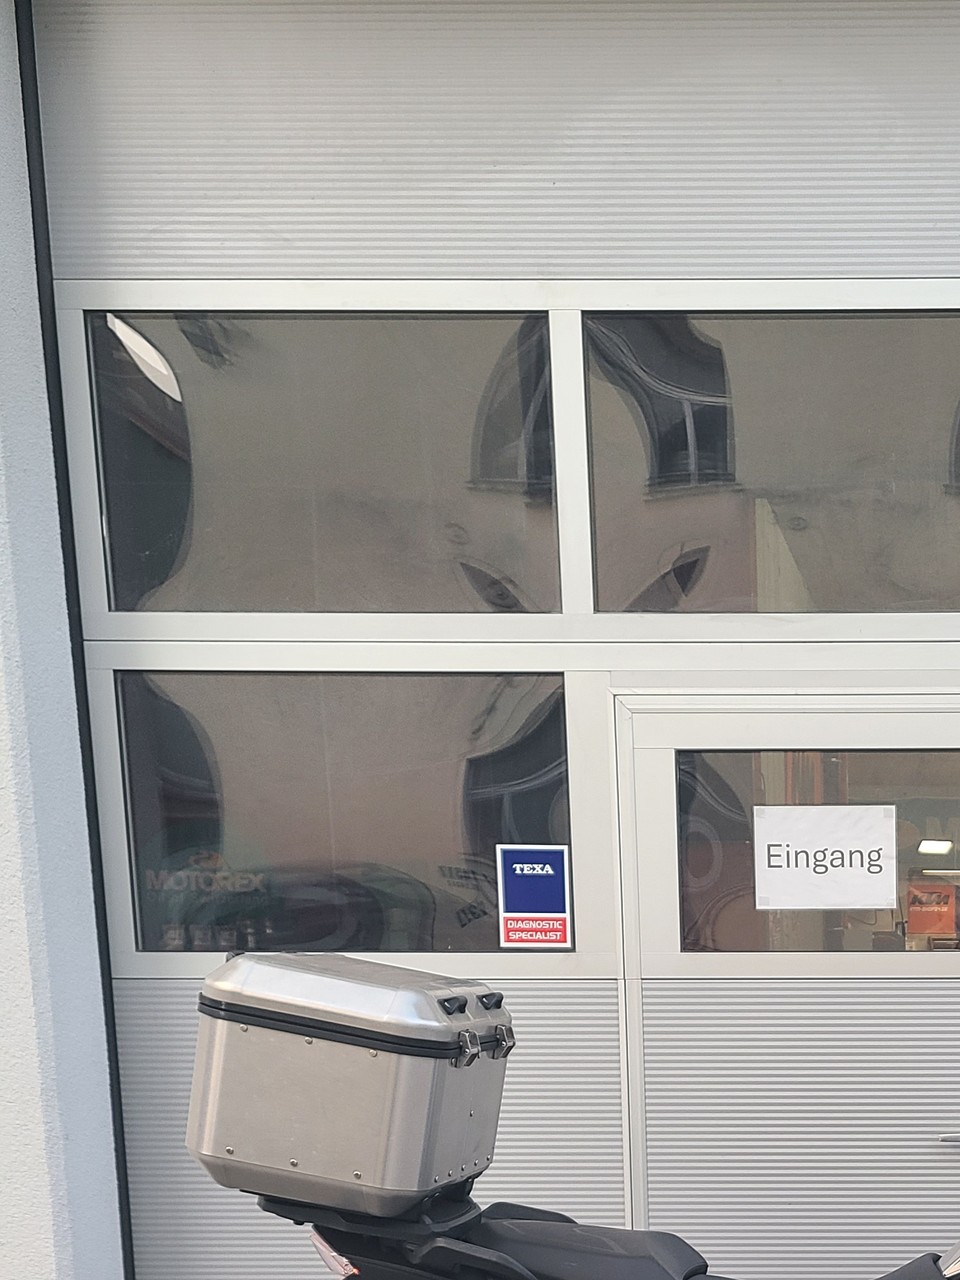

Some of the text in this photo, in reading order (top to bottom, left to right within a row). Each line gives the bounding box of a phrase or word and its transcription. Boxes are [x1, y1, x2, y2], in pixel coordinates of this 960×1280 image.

[766, 843, 883, 874] Eingang
[512, 864, 554, 875] TEXA
[507, 920, 563, 929] DIAGNOSTIC
[508, 931, 562, 941] SPECIALIST
